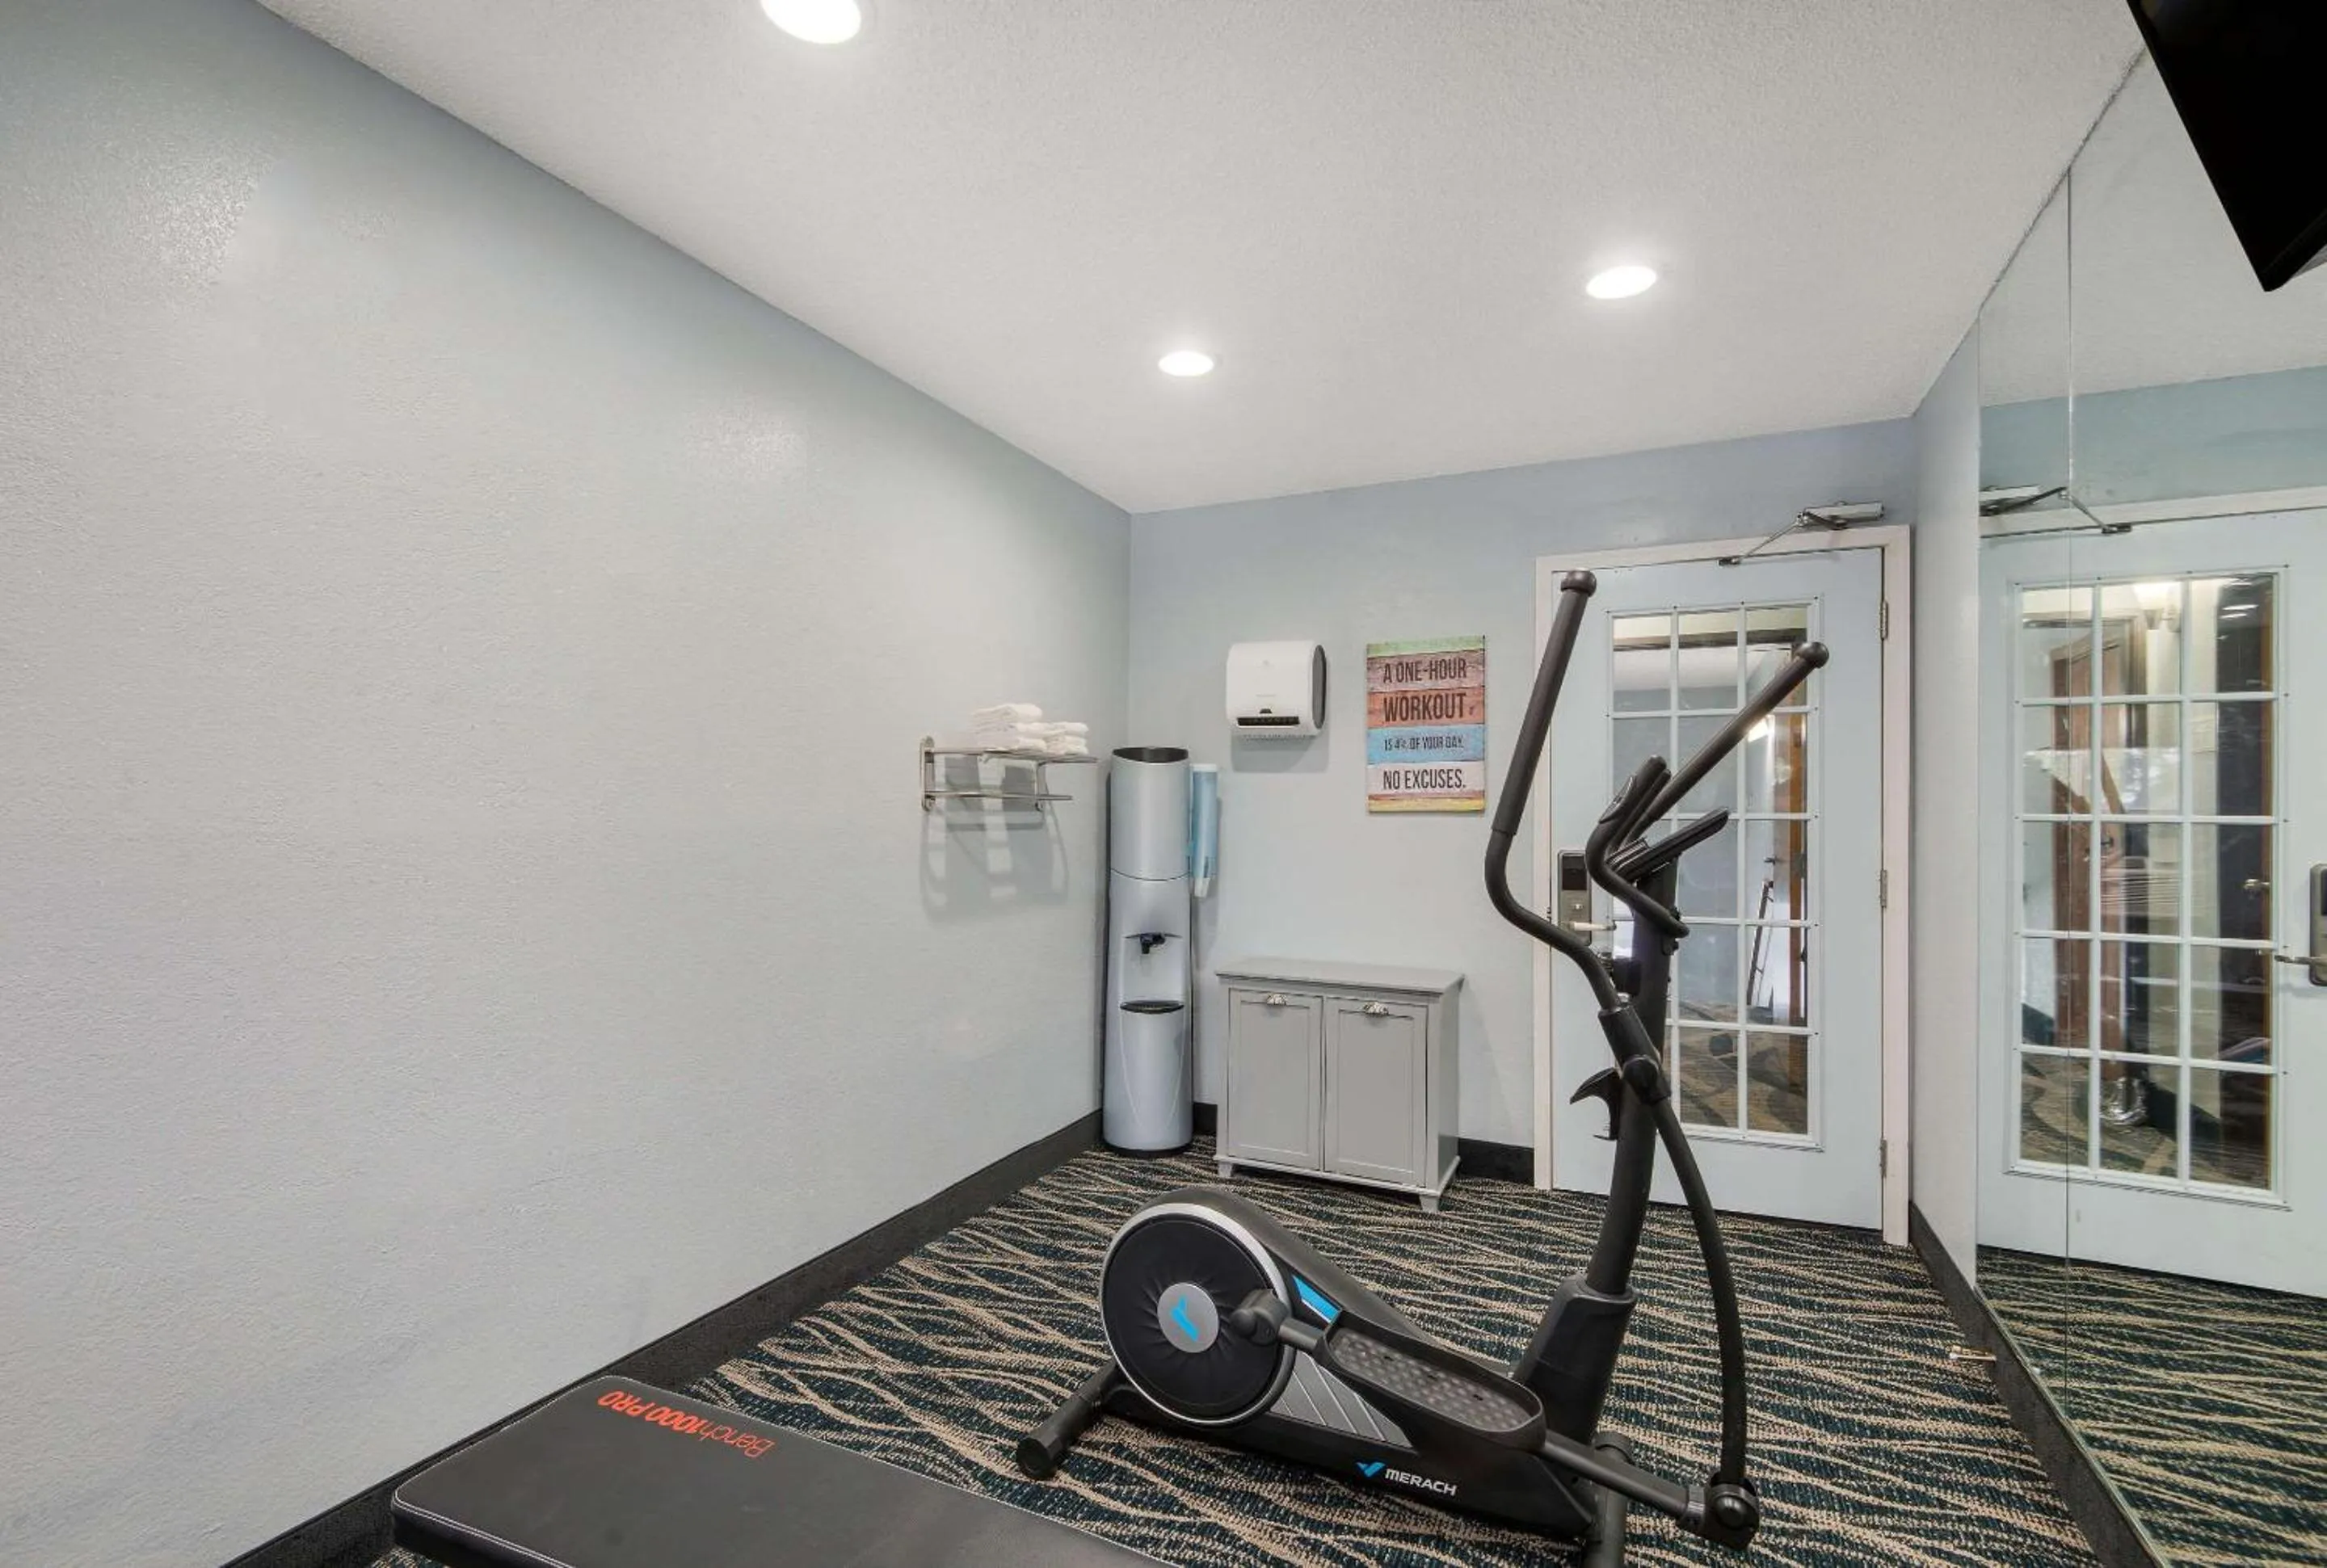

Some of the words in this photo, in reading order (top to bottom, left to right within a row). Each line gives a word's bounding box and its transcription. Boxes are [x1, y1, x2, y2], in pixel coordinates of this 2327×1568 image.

[1383, 662, 1392, 683] A
[1396, 658, 1466, 682] ONE-HOUR
[1384, 693, 1466, 721] WORKOUT
[1384, 738, 1392, 751] IS
[1409, 737, 1420, 750] OF
[1422, 735, 1444, 750] YOUR
[1383, 771, 1400, 789] NO
[1405, 769, 1466, 788] EXCUSES.
[597, 1389, 655, 1418] PRO
[1385, 1469, 1457, 1495] MERACH
